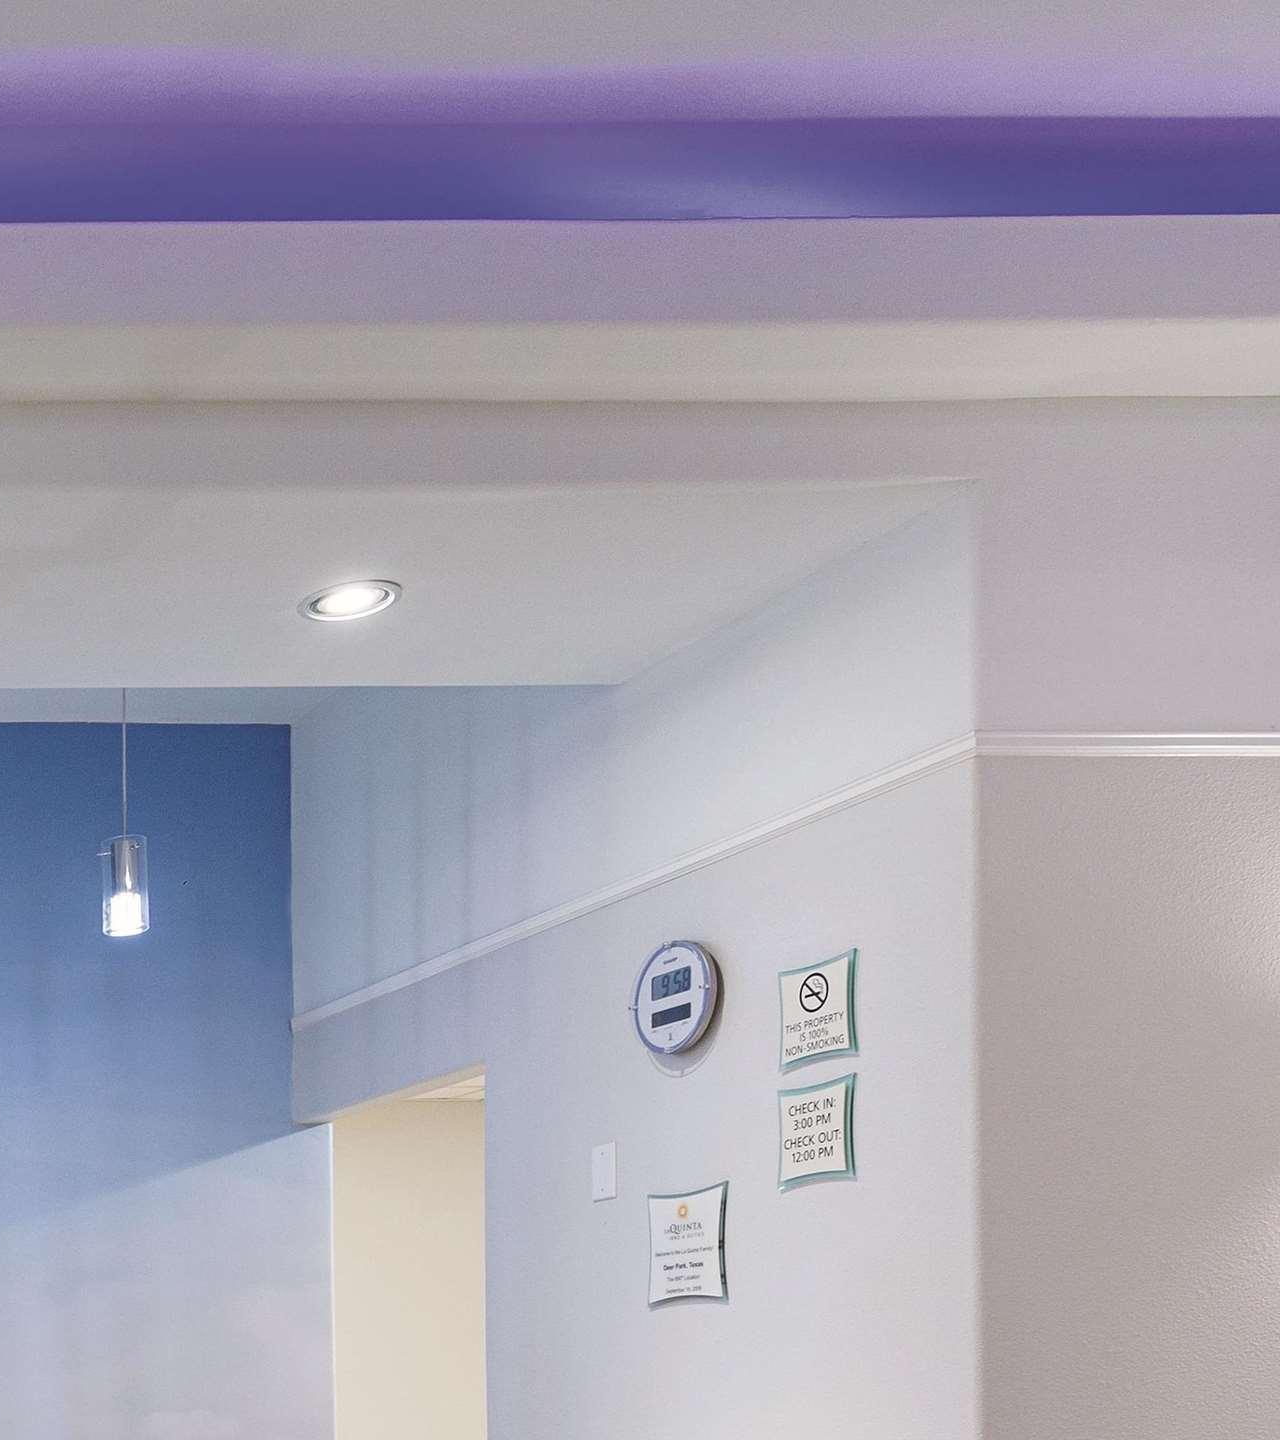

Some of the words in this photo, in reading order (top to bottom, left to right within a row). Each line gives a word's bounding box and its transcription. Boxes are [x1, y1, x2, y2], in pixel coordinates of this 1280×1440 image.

[785, 1021, 801, 1034] THIS
[804, 1010, 844, 1028] PROPERTY
[800, 1032, 806, 1042] IS
[808, 1027, 829, 1040] 100%
[785, 1033, 845, 1056] NON-SMOKING
[788, 1099, 820, 1117] CHECK
[823, 1097, 836, 1110] IN:
[793, 1116, 813, 1131] 3:00
[816, 1112, 831, 1126] PM
[784, 1134, 816, 1150] CHECK
[817, 1128, 842, 1143] OUT:
[792, 1148, 816, 1163] 12:00
[818, 1144, 834, 1158] PM
[669, 1222, 702, 1235] QUINTA
